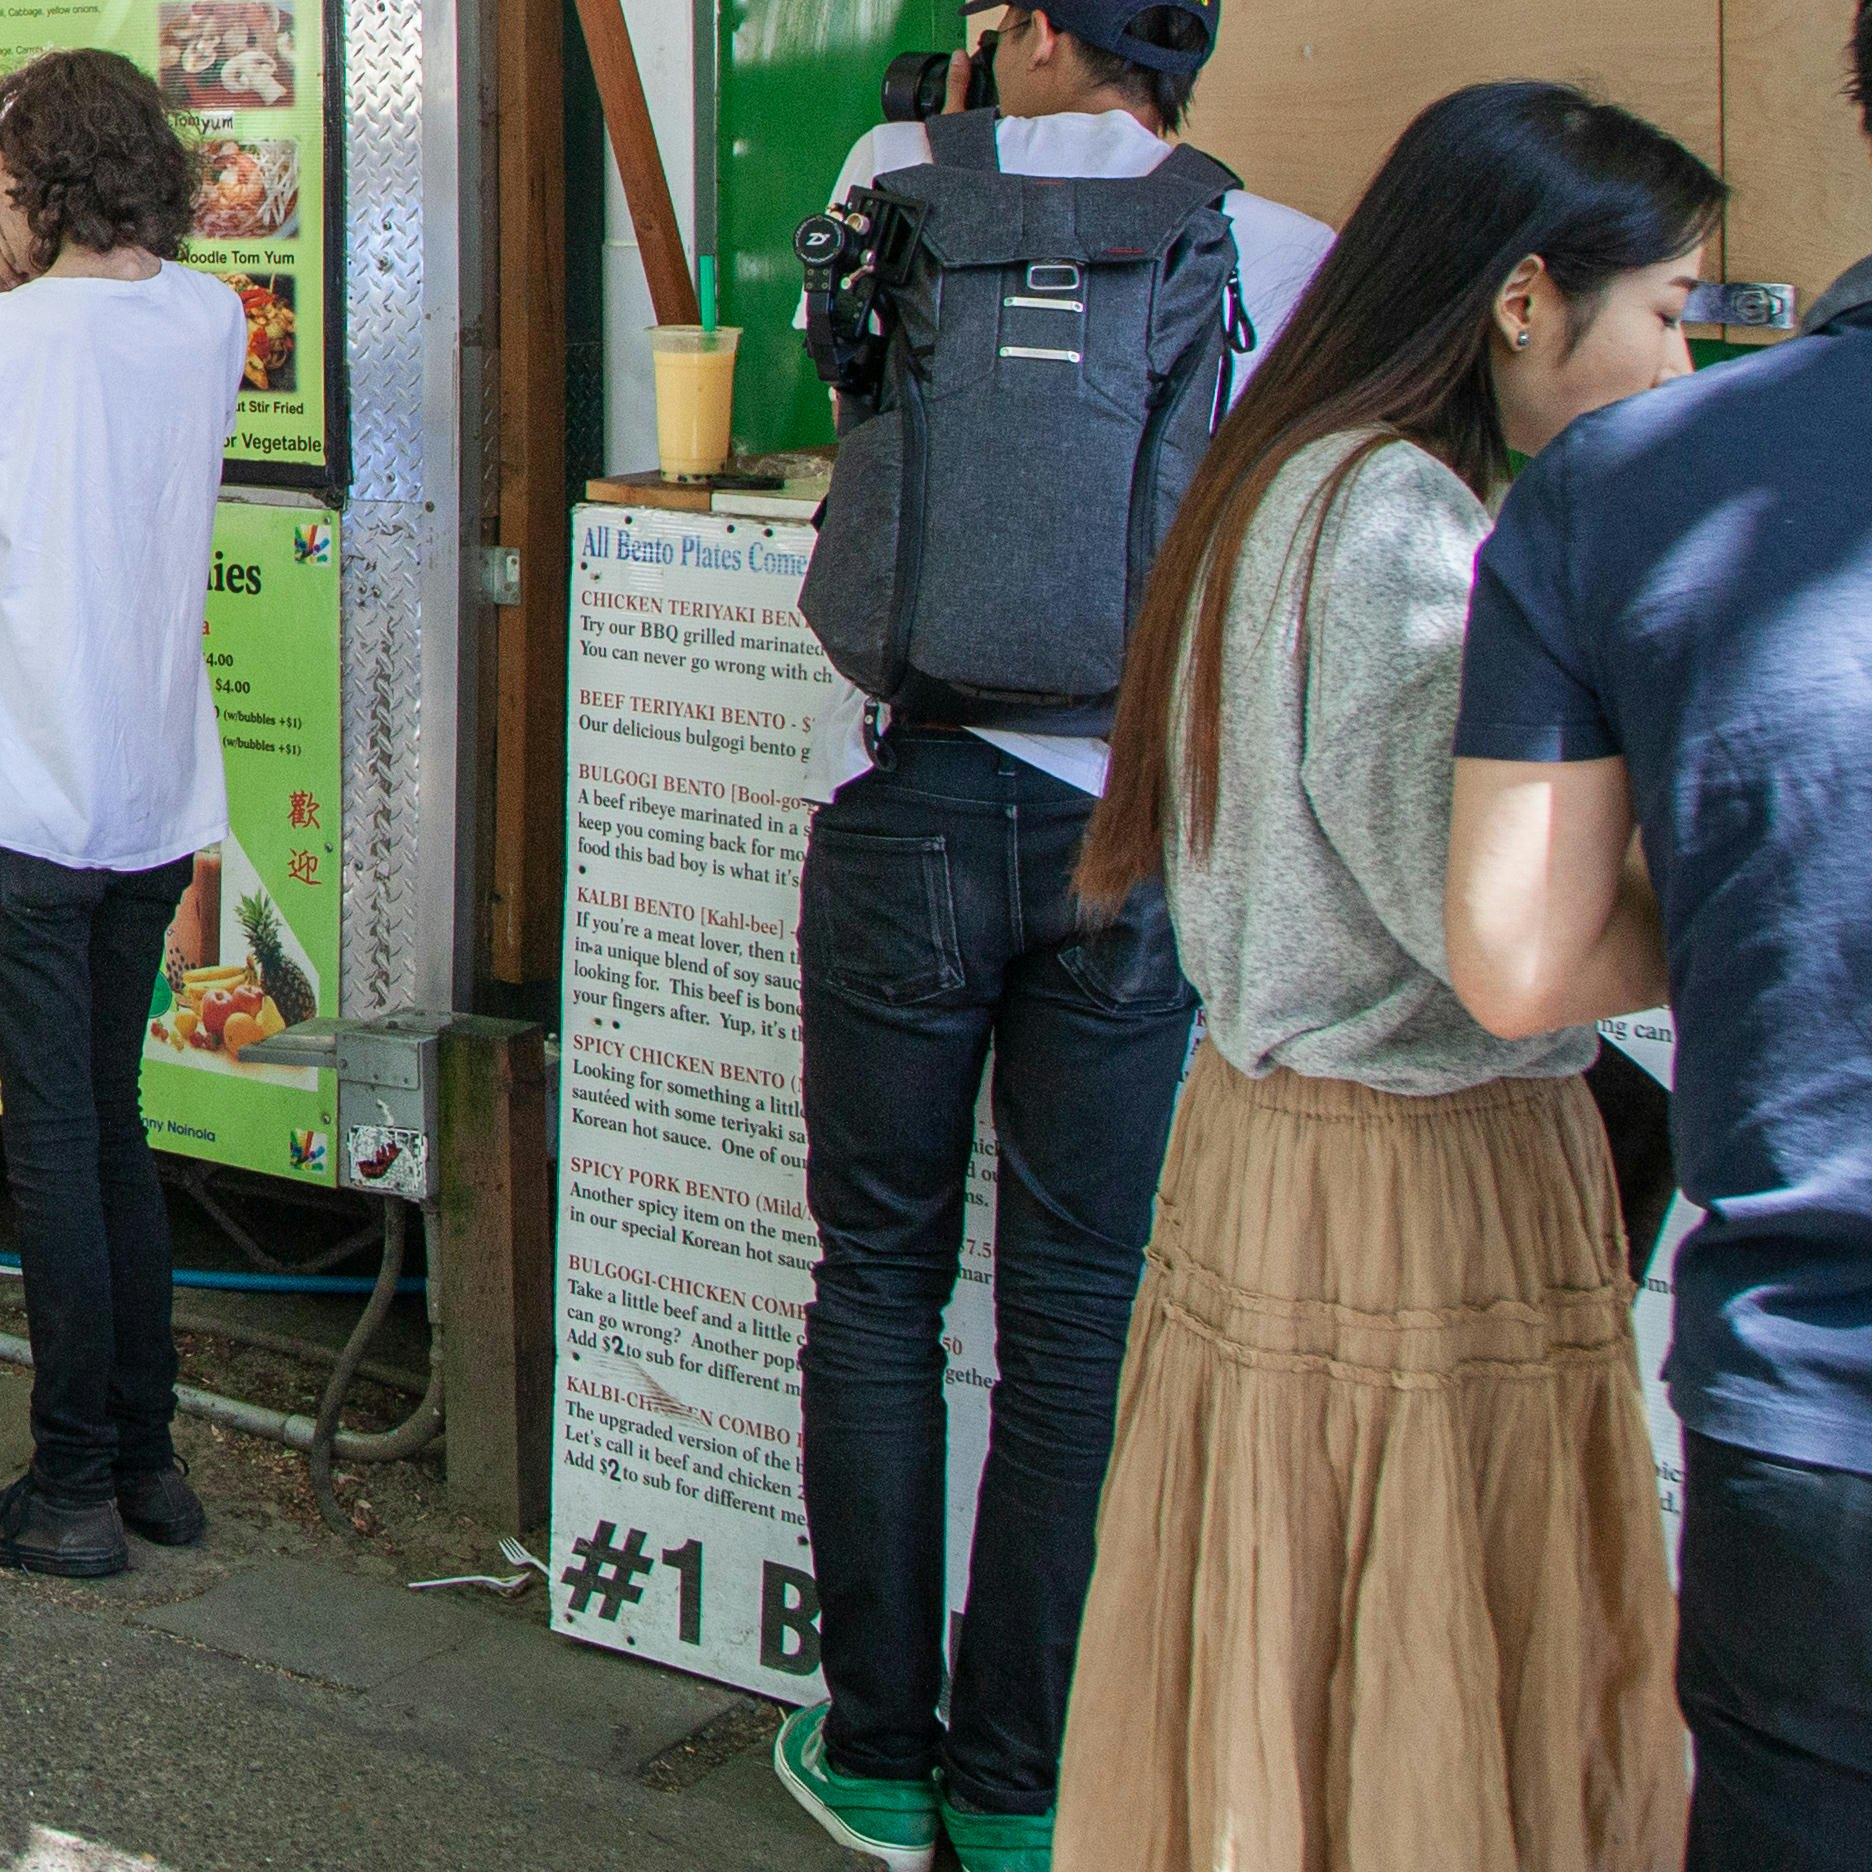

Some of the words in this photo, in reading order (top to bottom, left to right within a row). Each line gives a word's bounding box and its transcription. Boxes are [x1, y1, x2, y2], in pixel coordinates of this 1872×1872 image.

[241, 433, 322, 453] Vegetable
[582, 526, 609, 558] All
[617, 530, 673, 564] Bento
[681, 536, 741, 571] Plates
[582, 591, 662, 613] CHICKEN
[668, 600, 754, 623] TERIYAKI
[580, 615, 604, 636] Try
[609, 623, 635, 635] our
[641, 622, 678, 643] BBQ
[684, 628, 734, 647] grilled
[580, 640, 607, 658] You
[612, 649, 638, 661] can
[644, 652, 686, 667] never
[691, 658, 709, 673] go
[715, 660, 765, 680] wrong
[771, 663, 807, 680] with
[215, 678, 251, 695] $4.00
[580, 689, 625, 709] BEEF
[630, 696, 714, 721] TERIYAKI
[722, 707, 785, 729] BENTO
[579, 715, 608, 733] Our
[613, 718, 680, 742] delicious
[686, 727, 744, 754] bulgogi
[751, 735, 796, 757] bento
[578, 887, 628, 910] KALBI
[635, 897, 694, 921] BENTO
[701, 907, 783, 939] [Kahl-bee]
[571, 1157, 623, 1181] SPICY
[630, 1169, 680, 1193] PORK
[686, 1180, 750, 1207] BENTO
[569, 1255, 746, 1307] BULGOGI-CHICKEN
[560, 1519, 702, 1647] #1
